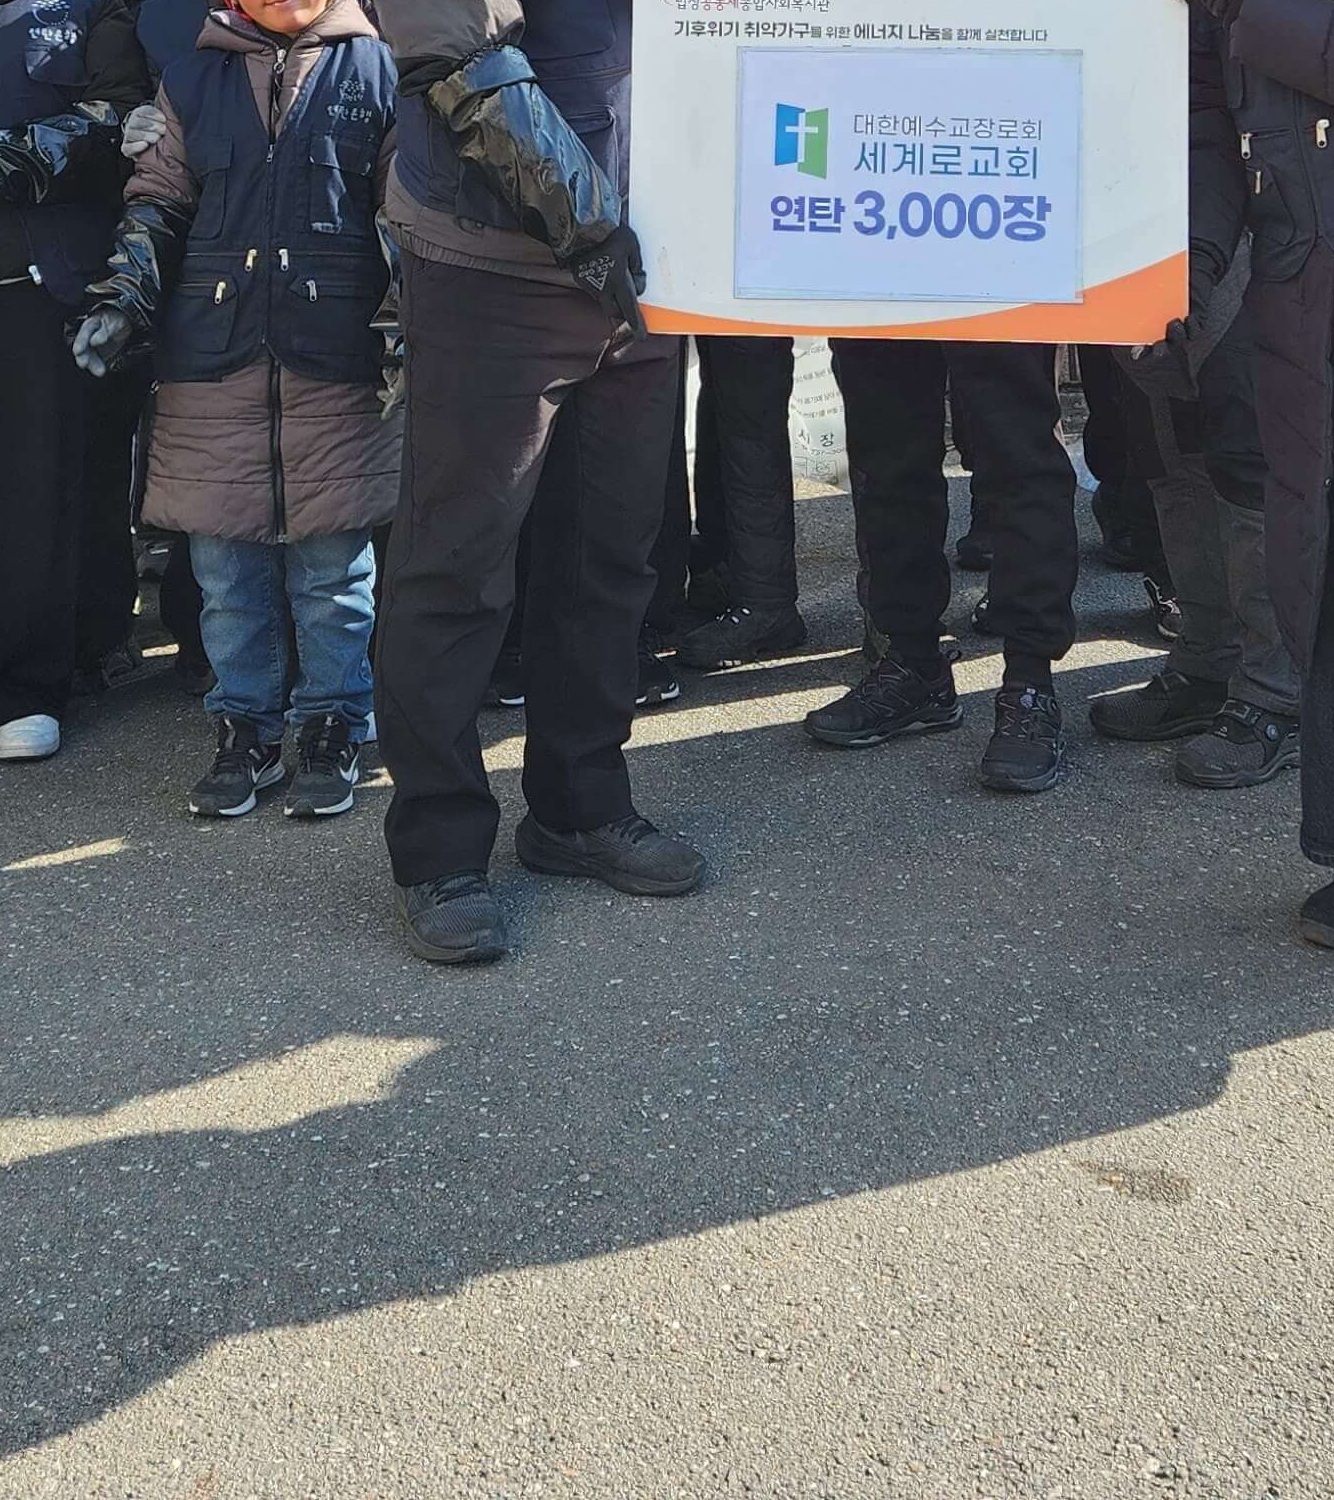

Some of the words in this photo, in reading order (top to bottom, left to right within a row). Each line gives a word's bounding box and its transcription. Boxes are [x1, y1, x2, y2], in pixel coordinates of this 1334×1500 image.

[674, 20, 740, 38] 기후위기
[744, 21, 822, 39] 취약가구를
[825, 25, 851, 39] 위한
[853, 22, 903, 40] 에너지
[908, 23, 953, 41] 나눔을
[956, 27, 982, 41] 함께
[985, 28, 1049, 42] 실천합니다
[853, 113, 1043, 141] 대한예수교장로회
[853, 141, 1039, 181] 세계로교회
[770, 195, 846, 233] 연탄
[853, 190, 1052, 242] 3,000장
